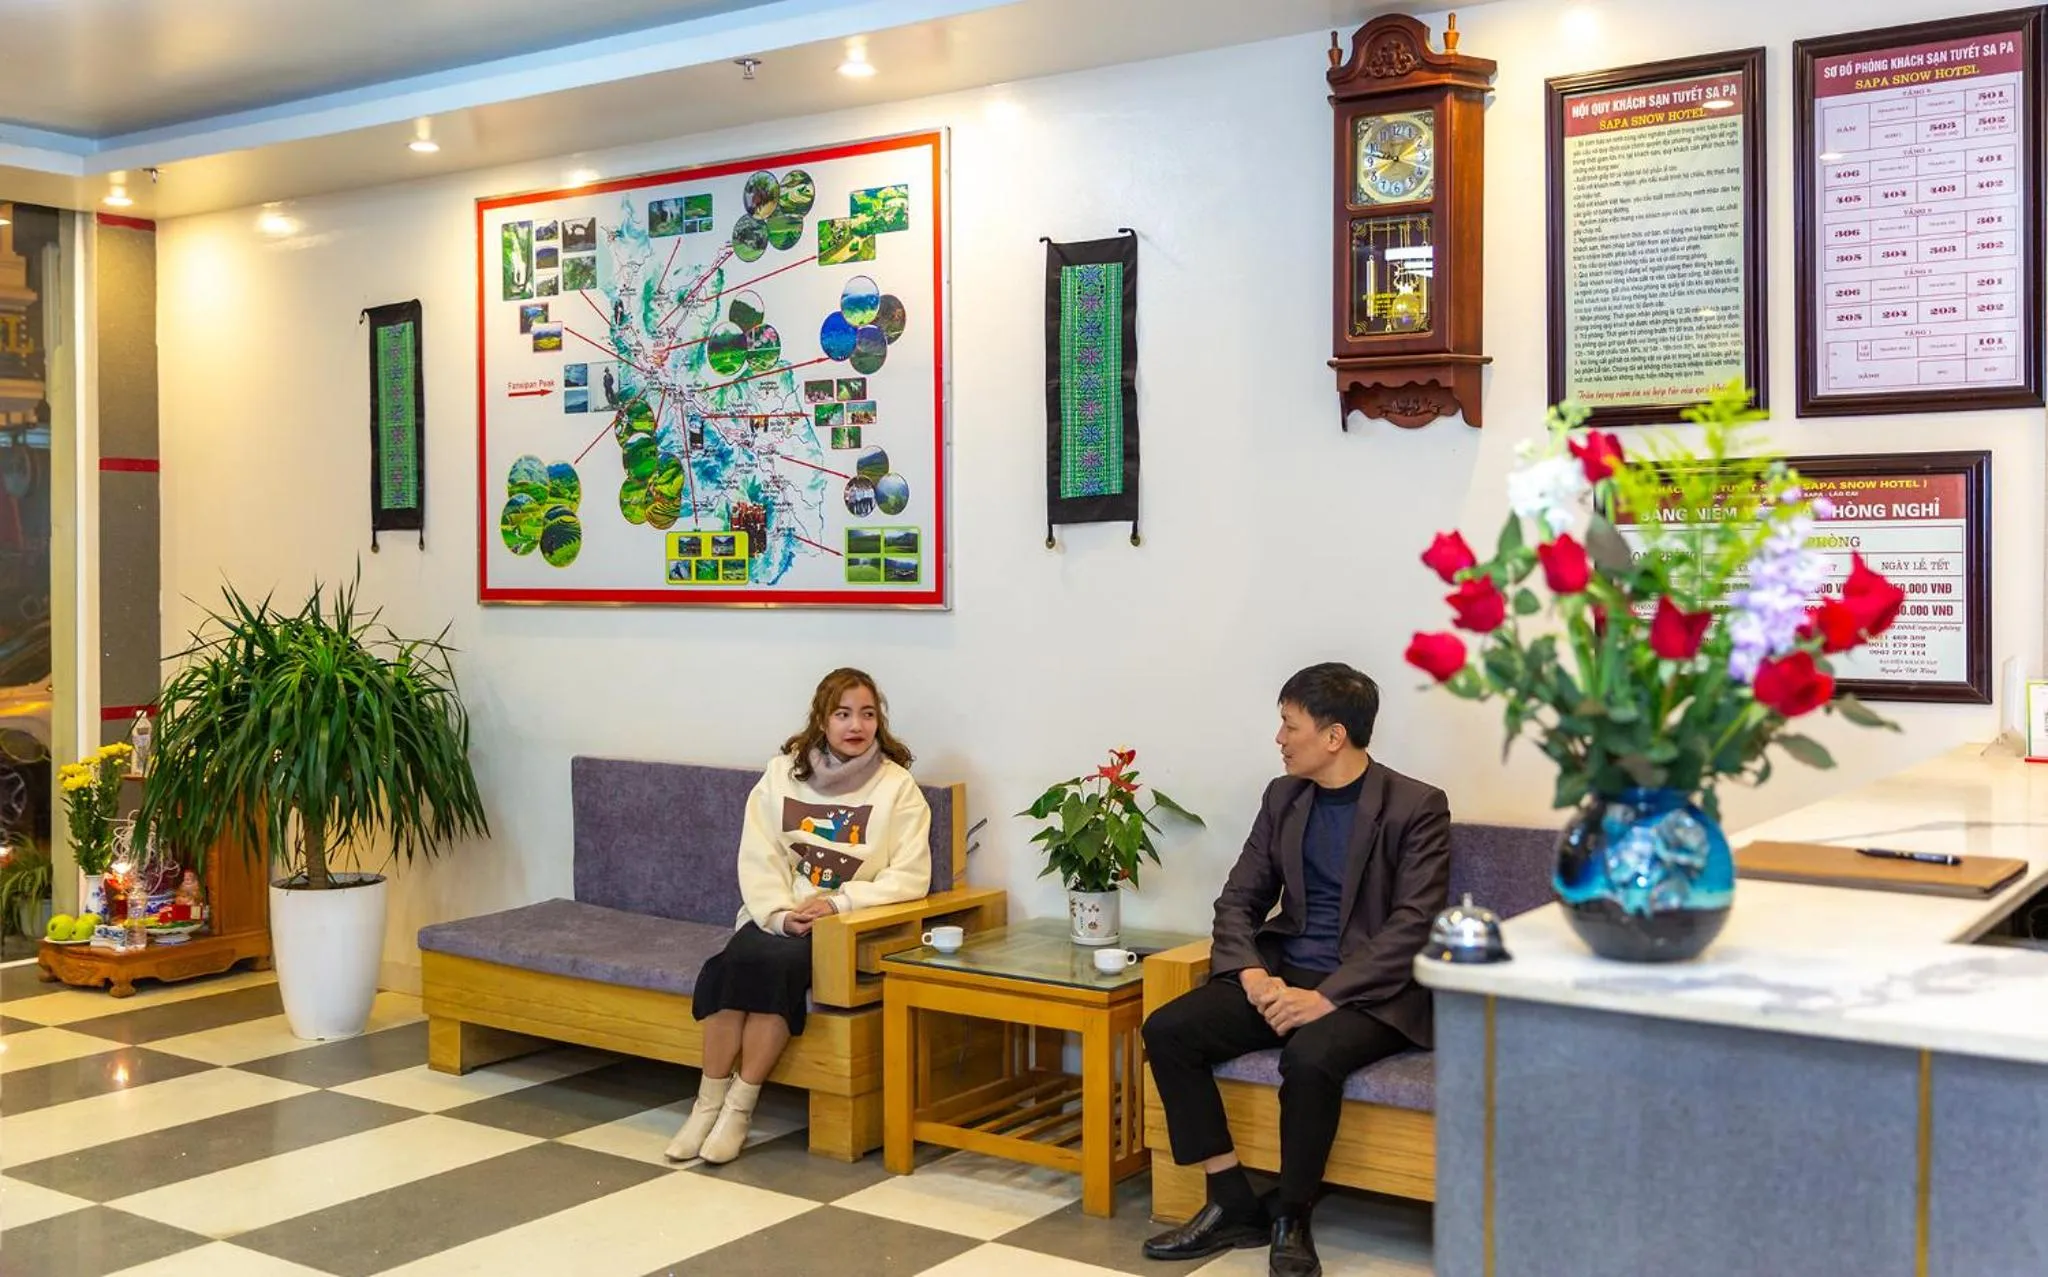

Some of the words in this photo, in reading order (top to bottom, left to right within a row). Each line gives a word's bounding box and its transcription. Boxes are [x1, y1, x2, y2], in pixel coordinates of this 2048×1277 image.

[1823, 65, 1838, 79] SƠ
[1854, 59, 1888, 74] PHÒNG
[1890, 53, 1923, 71] KHÁCH
[1926, 51, 1948, 67] SẠN
[1949, 43, 1980, 62] TUYẾT
[1983, 44, 1997, 57] SA
[1999, 41, 2014, 54] PA
[1855, 76, 1889, 90] SAPA
[1892, 69, 1932, 85] SNOW
[1935, 64, 1980, 80] HOTEL
[1572, 104, 1589, 118] NỘI
[1591, 101, 1610, 115] QUY
[1612, 96, 1646, 111] KHÁCH
[1649, 95, 1670, 109] SẠN
[1672, 84, 1703, 104] TUYẾT
[1706, 87, 1720, 99] SA
[1722, 84, 1737, 96] PA
[1599, 117, 1628, 131] SAPA
[1631, 112, 1666, 126] SNOW
[1668, 107, 1707, 122] HOTEL
[1835, 288, 1860, 298] 206
[1976, 277, 2003, 287] 201
[1929, 305, 1958, 316] 203
[1976, 302, 2004, 312] 202
[1978, 337, 2003, 346] 101
[1803, 481, 1836, 491] SAPA
[1839, 480, 1878, 490] SNOW
[1879, 479, 1921, 489] HOTEL
[1832, 499, 1887, 519] HÒNG
[1892, 496, 1940, 518] NGHỈ
[1806, 533, 1861, 548] PHÒNG
[1881, 561, 1910, 571] NGÀY
[1932, 605, 1954, 617] VNĐ
